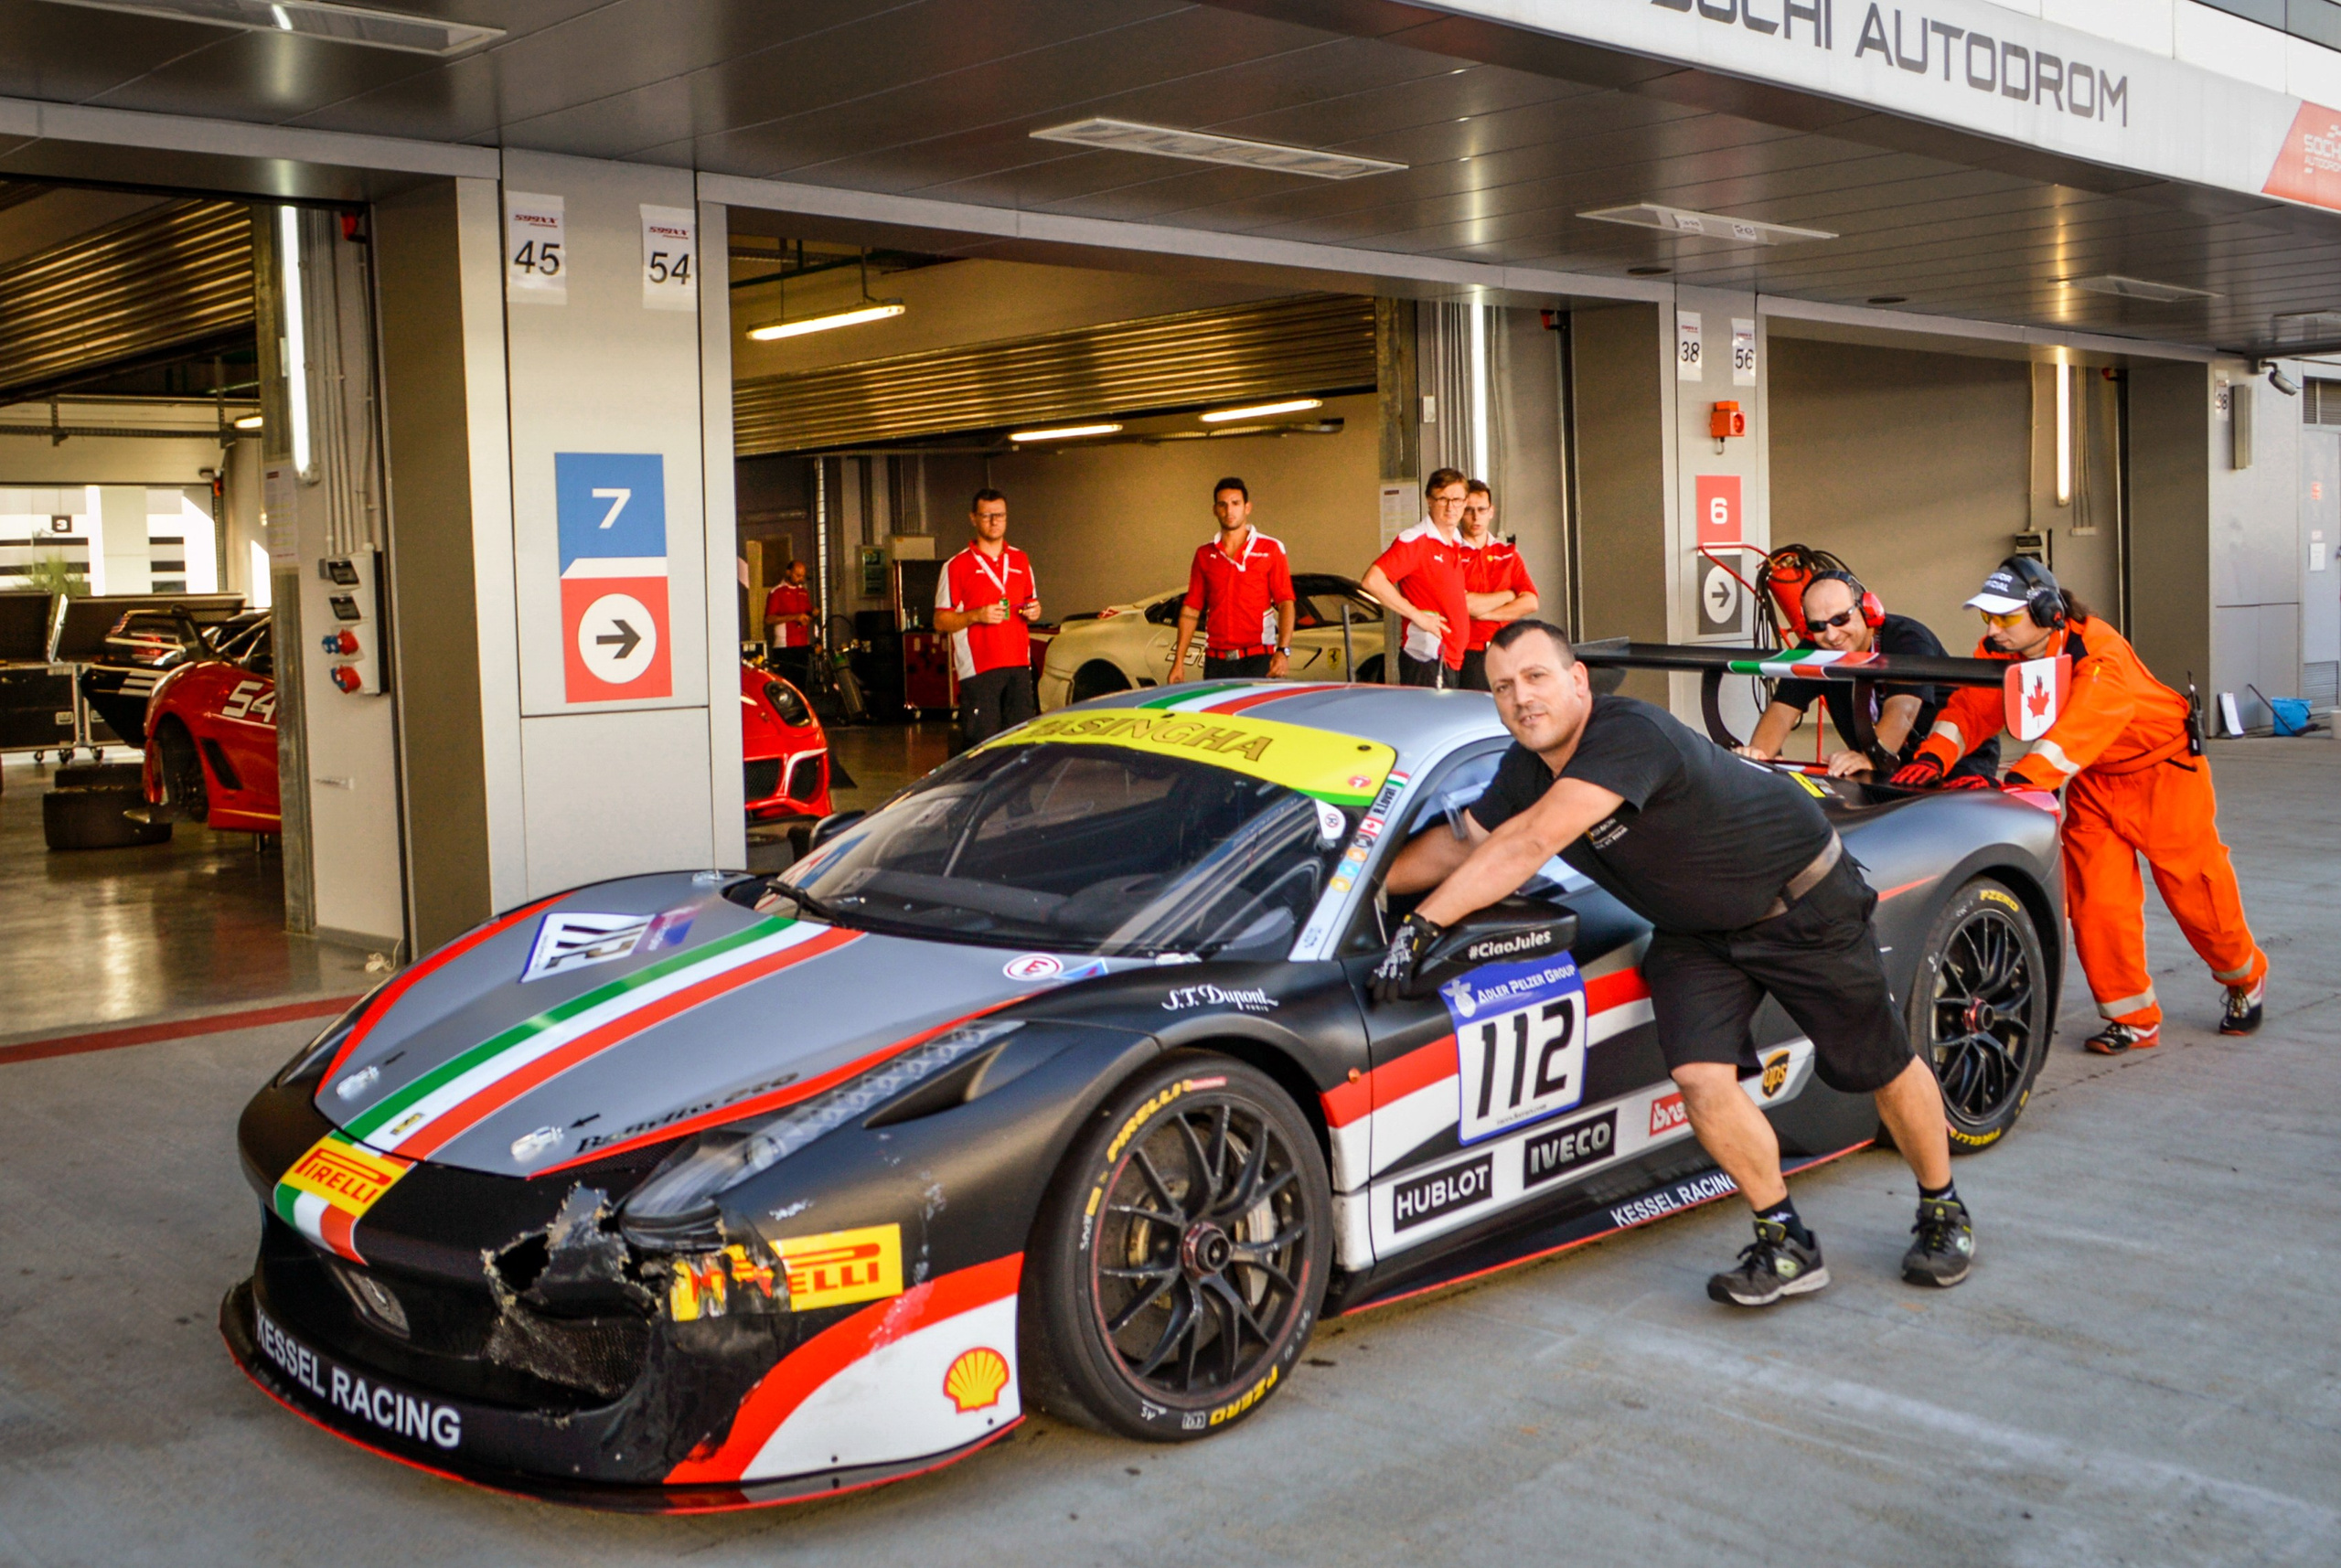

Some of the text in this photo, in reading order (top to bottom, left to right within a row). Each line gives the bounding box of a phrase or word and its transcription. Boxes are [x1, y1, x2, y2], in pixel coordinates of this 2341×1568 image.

[1651, 0, 2128, 127] CHI AUTODROM
[2304, 133, 2341, 160] SOCH
[514, 240, 561, 275] 45
[648, 251, 690, 285] 54
[1680, 341, 1700, 363] 38
[1735, 348, 1755, 369] 56
[56, 519, 68, 530] 3
[592, 488, 632, 529] 7
[1710, 497, 1728, 524] 6
[221, 680, 275, 723] 54
[1062, 717, 1273, 762] SINGHA
[1468, 931, 1552, 960] #CiaoJules
[1200, 983, 1278, 1011] Dupont
[1477, 964, 1577, 1005] ADLER PELZER GROUP
[1476, 997, 1575, 1121] 112
[1764, 1063, 1789, 1093] ups
[1652, 1101, 1688, 1132] bre
[1530, 1121, 1611, 1176] IVECO
[294, 1147, 392, 1205] PIRELLI
[1396, 1164, 1491, 1221] HUBLOT
[1610, 1192, 1681, 1228] KESSEL
[256, 1308, 461, 1448] KESSEL RACING
